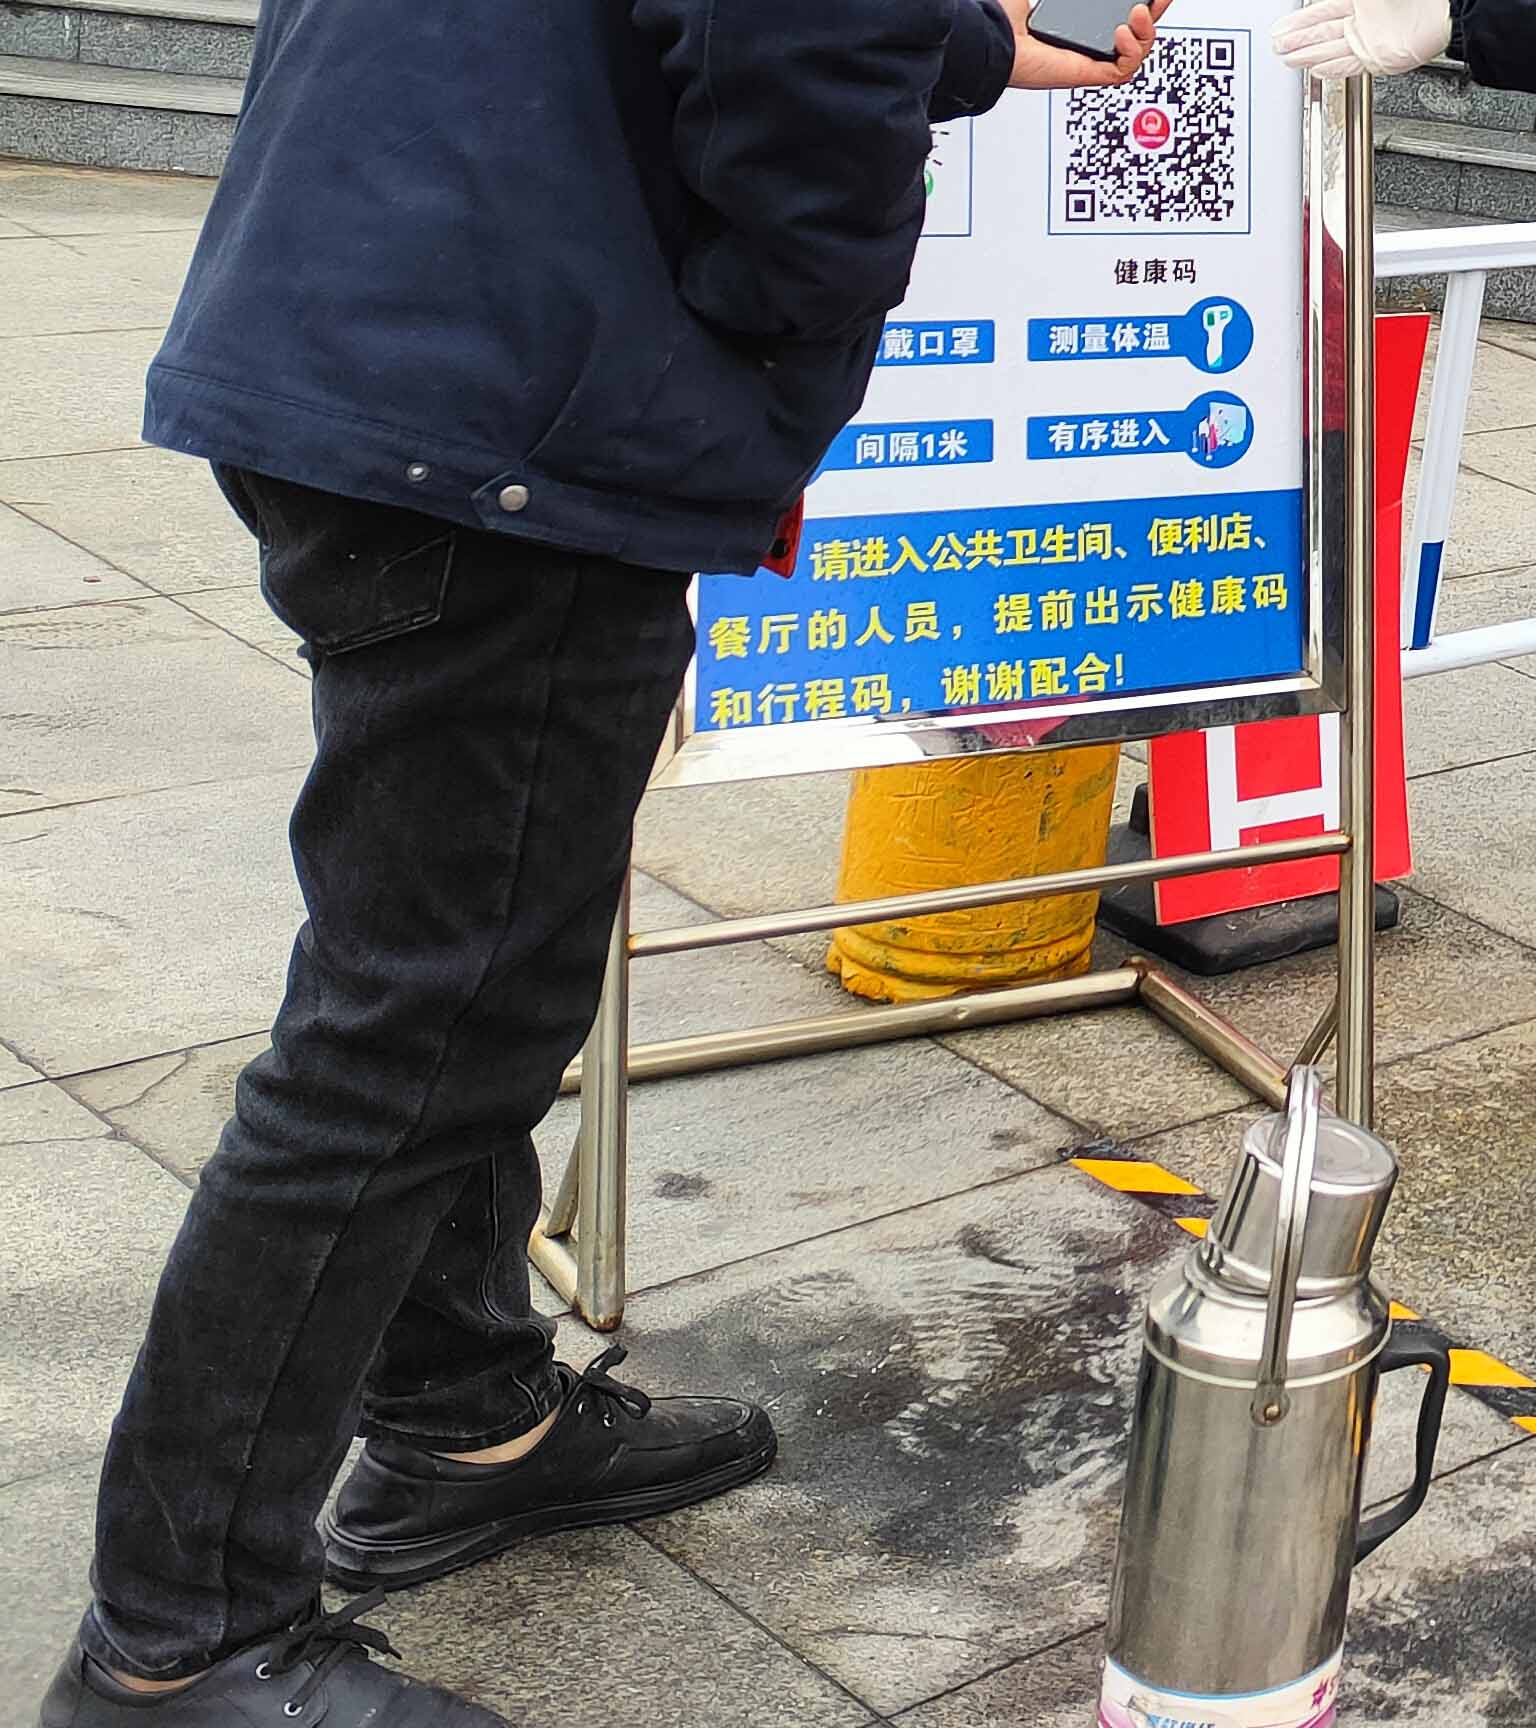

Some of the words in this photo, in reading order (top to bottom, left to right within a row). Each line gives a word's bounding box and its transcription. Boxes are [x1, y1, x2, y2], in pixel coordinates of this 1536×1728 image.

[1113, 257, 1198, 286] 健康码
[876, 327, 980, 359] 戴口罩
[1048, 323, 1171, 355] 测量体温
[855, 429, 968, 464] 间隔1米
[1048, 420, 1171, 452] 有序进入
[809, 512, 1269, 583] 请进入公共卫生间、便利店、
[708, 574, 1289, 661] 餐厅的人员，提前出示健康码
